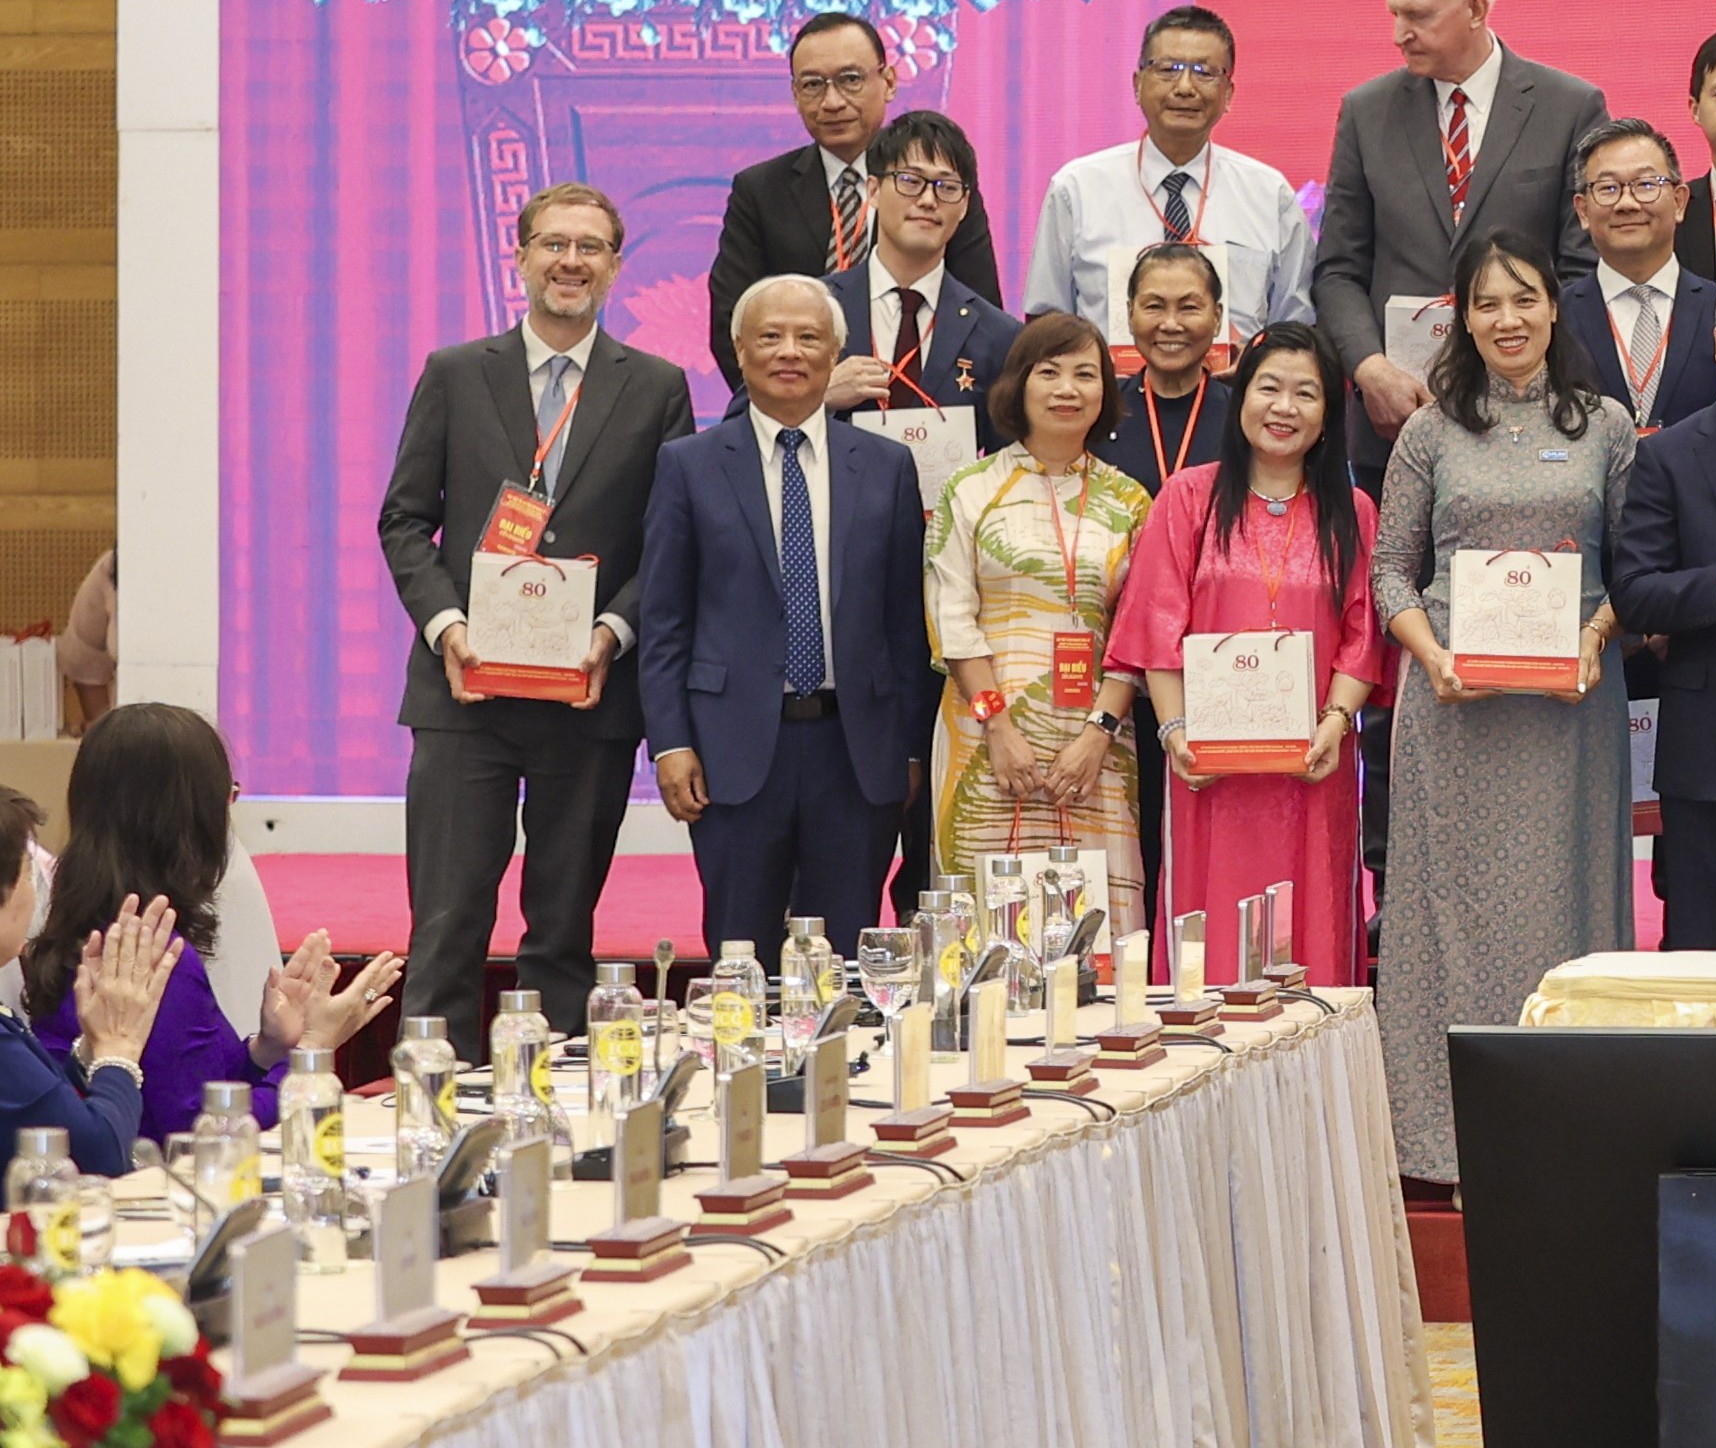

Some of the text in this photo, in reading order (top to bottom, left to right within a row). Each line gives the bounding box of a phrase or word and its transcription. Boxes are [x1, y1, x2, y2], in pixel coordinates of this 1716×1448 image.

[903, 427, 928, 443] 80
[1506, 570, 1532, 586] 80
[519, 582, 546, 598] 80
[1234, 654, 1260, 670] 80
[1629, 716, 1652, 733] 80
[1035, 871, 1045, 886] 8
